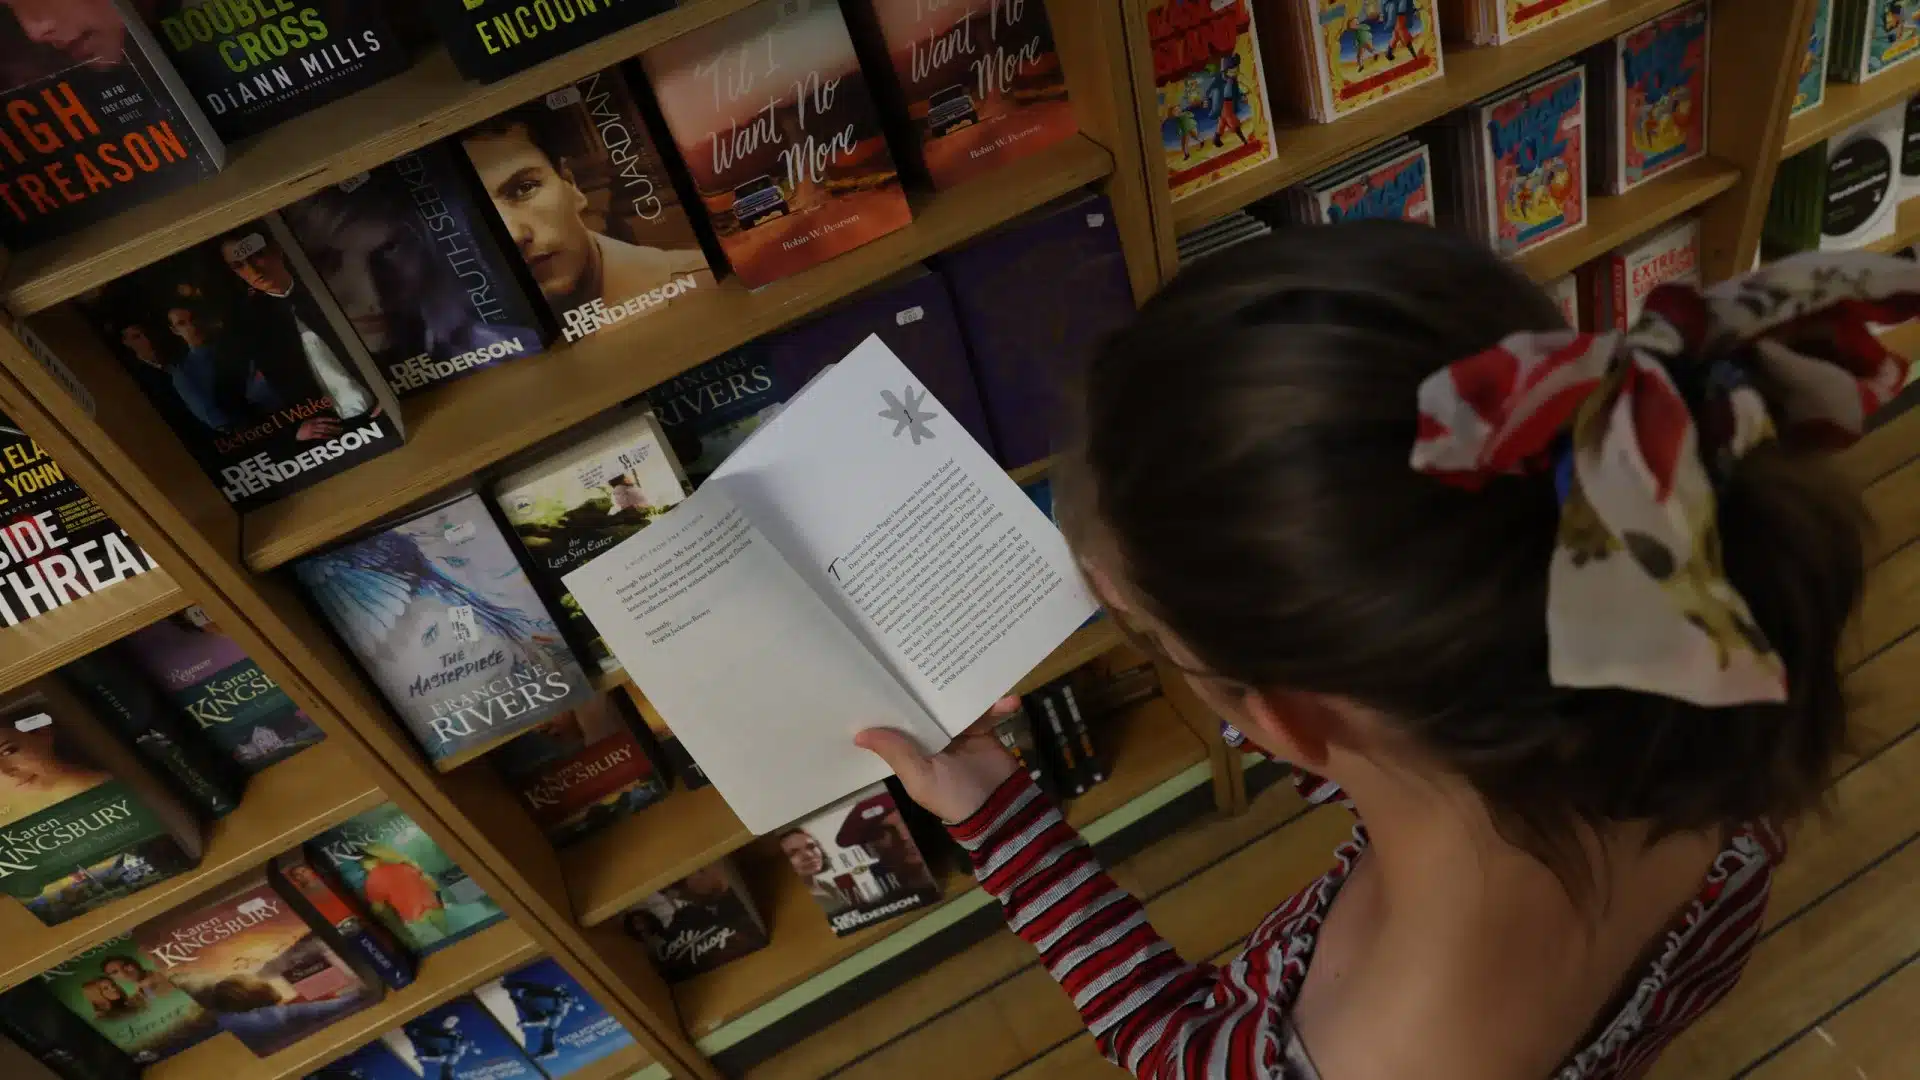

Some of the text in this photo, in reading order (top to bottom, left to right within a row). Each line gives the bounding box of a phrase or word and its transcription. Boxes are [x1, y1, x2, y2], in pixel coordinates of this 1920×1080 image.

[217, 7, 329, 73] CROSS
[300, 29, 381, 78] MILLS
[908, 11, 977, 83] Want
[970, 36, 1042, 100] More
[0, 79, 101, 173] IGH
[577, 72, 663, 221] GUARDIAN
[709, 69, 842, 174] Want No
[970, 140, 997, 160] Robin
[0, 119, 188, 224] TREASON
[778, 123, 858, 191] More
[396, 152, 460, 234] SEEKE
[781, 230, 811, 252] Robin
[823, 213, 861, 234] Pearson
[447, 232, 499, 325] TRUTH
[561, 274, 697, 343] HENDERSON
[563, 297, 606, 326] DEE
[391, 353, 434, 378] DEE
[391, 336, 525, 395] HENDERSON
[282, 394, 333, 424] Wake
[3, 437, 52, 471] ELA
[4, 459, 66, 498] YOHN
[219, 451, 276, 486] DEE
[221, 421, 385, 504] HENDERSON
[0, 509, 69, 571] IDE
[547, 536, 614, 570] Last Sin Eater
[683, 540, 697, 551] hope
[0, 527, 159, 626] THREA
[204, 667, 259, 697] Karen
[408, 649, 505, 697] MASTERPIECE
[439, 650, 465, 670] THE
[184, 673, 279, 729] KINGS
[427, 671, 571, 744] RIVERS
[430, 662, 549, 717] FRANCINE
[0, 799, 132, 879] KINGSBURY
[1, 817, 61, 846] Karen
[152, 900, 281, 969] KINGSBURY
[172, 916, 222, 941] Karen
